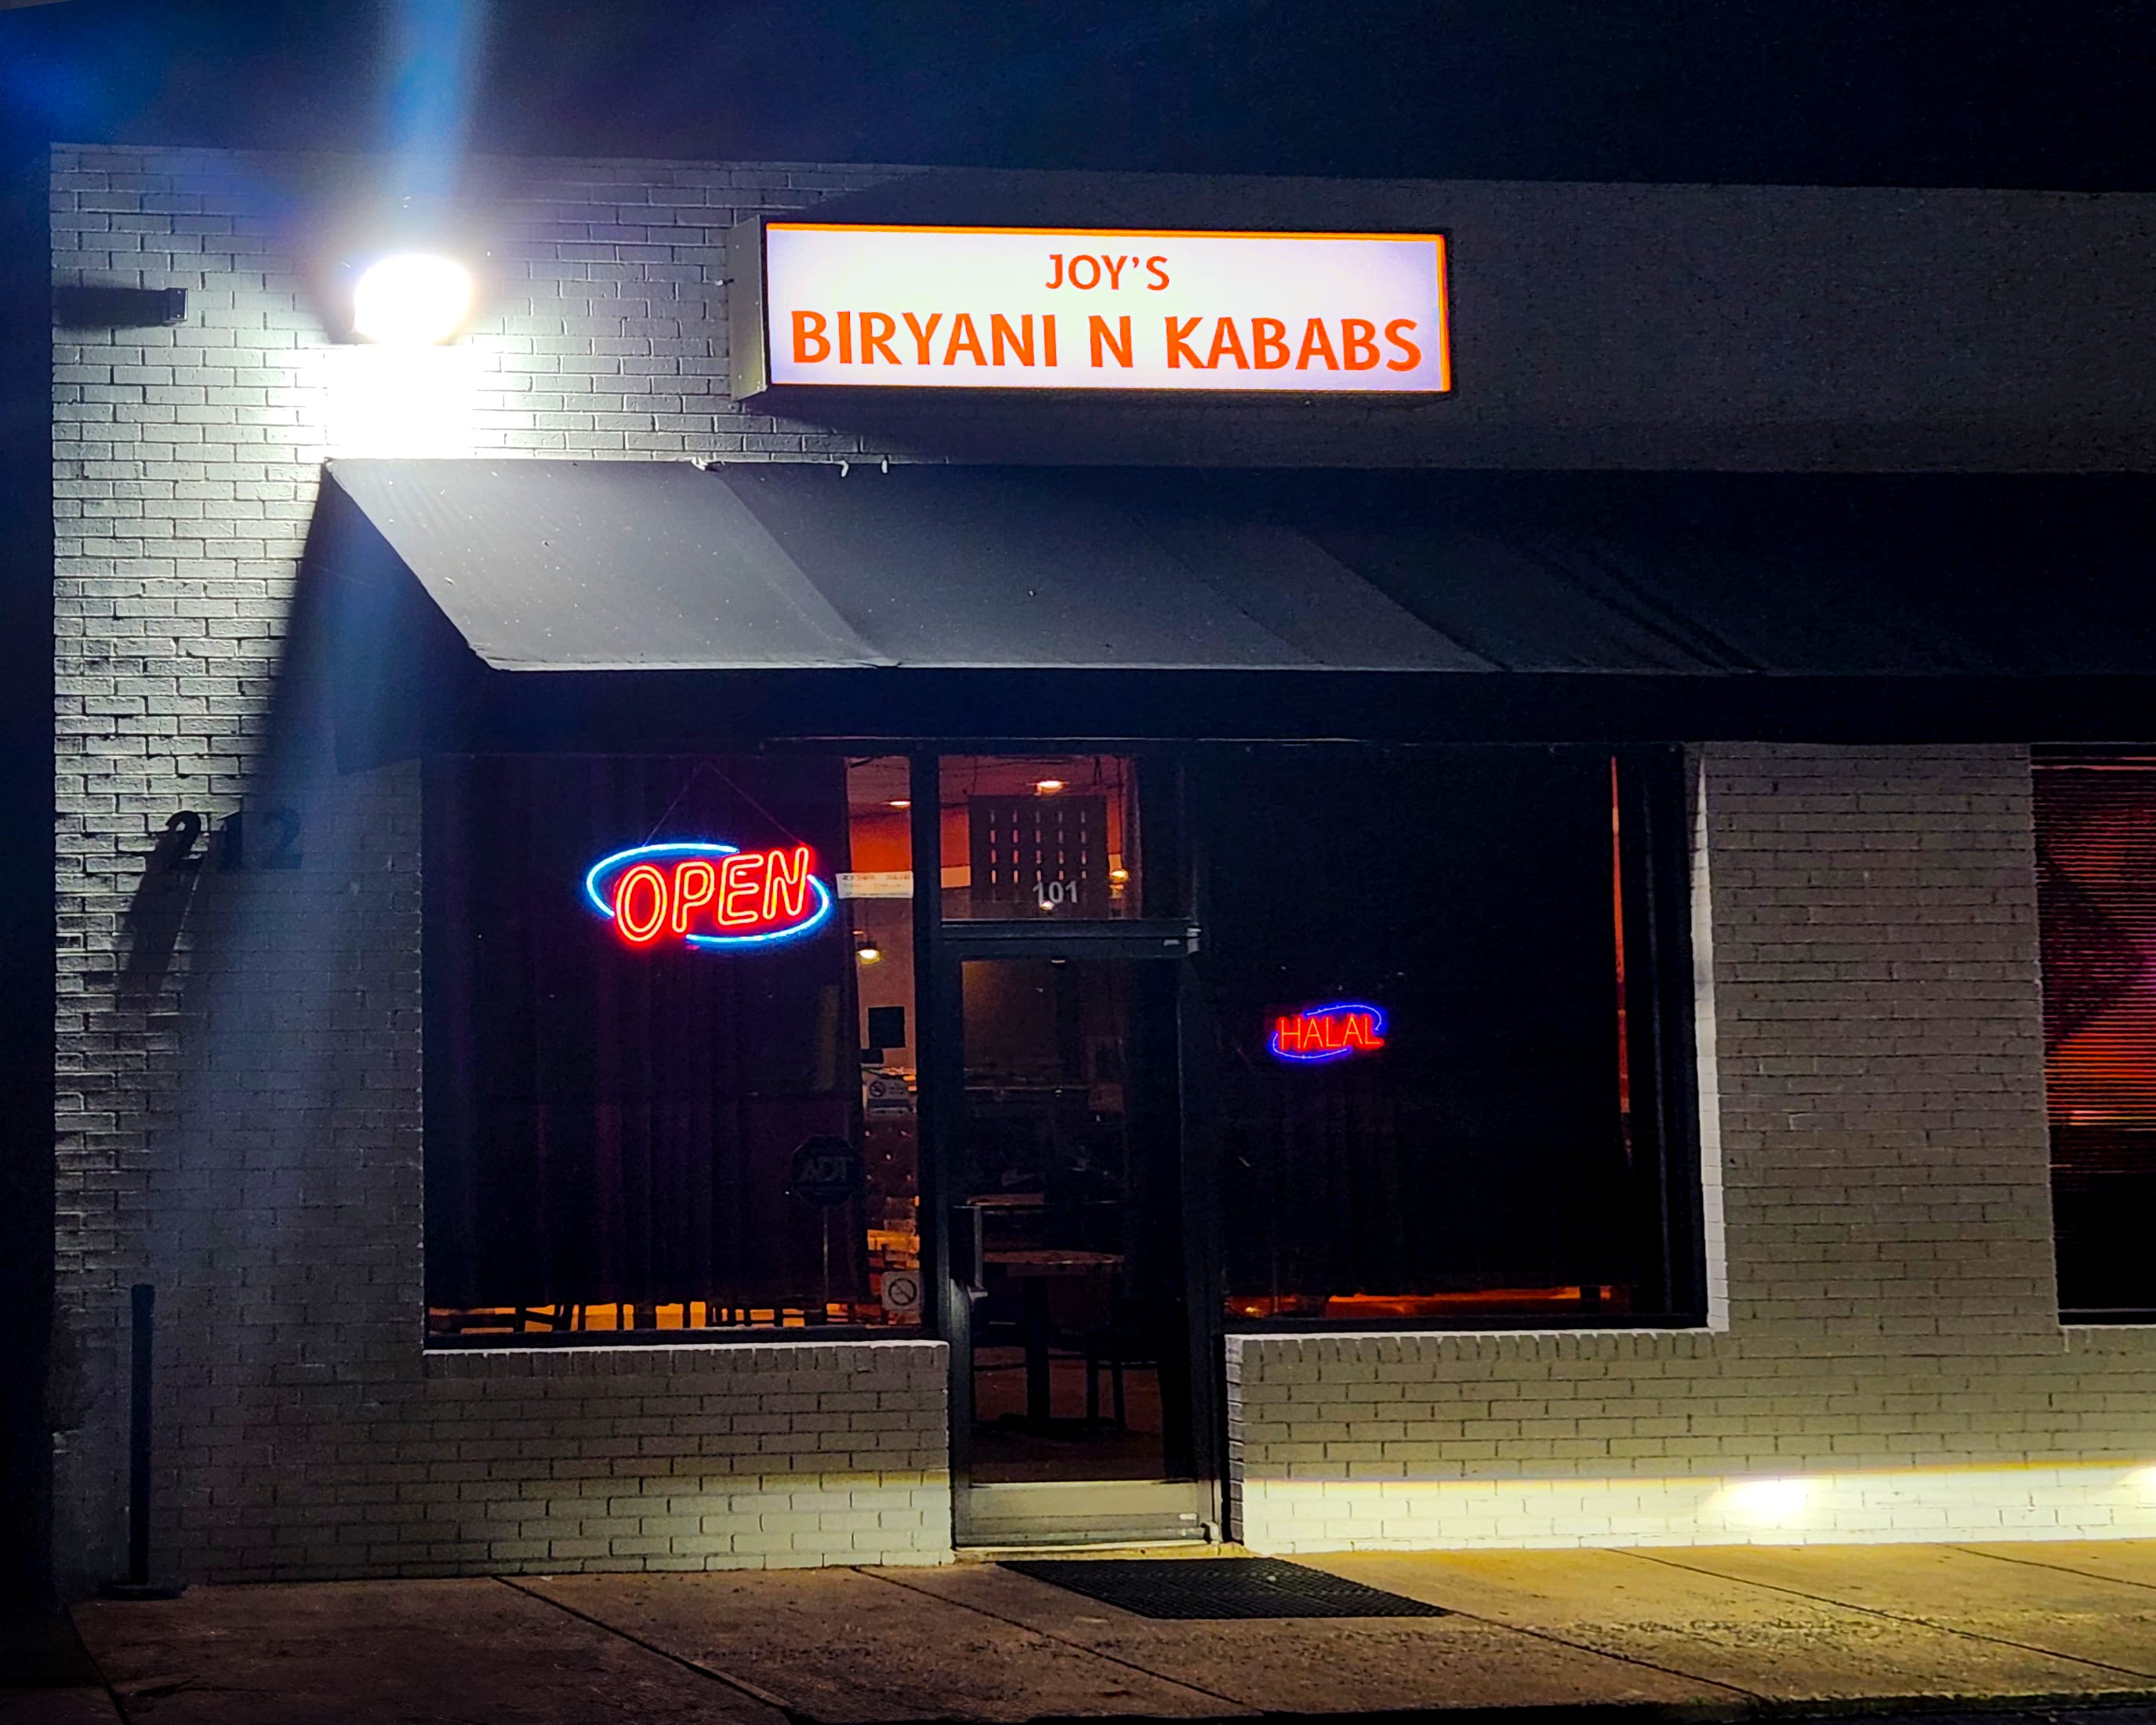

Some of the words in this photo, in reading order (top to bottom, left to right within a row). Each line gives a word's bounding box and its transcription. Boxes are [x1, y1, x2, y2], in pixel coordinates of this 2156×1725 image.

[1045, 254, 1170, 292] JOY'S
[792, 310, 1058, 368] BIRYANI
[1089, 315, 1134, 369] N
[1165, 316, 1422, 372] KABABS
[615, 844, 811, 943] OPEN
[1032, 881, 1080, 904] 101
[1279, 1013, 1384, 1051] HALAL
[798, 1156, 854, 1183] ADT
